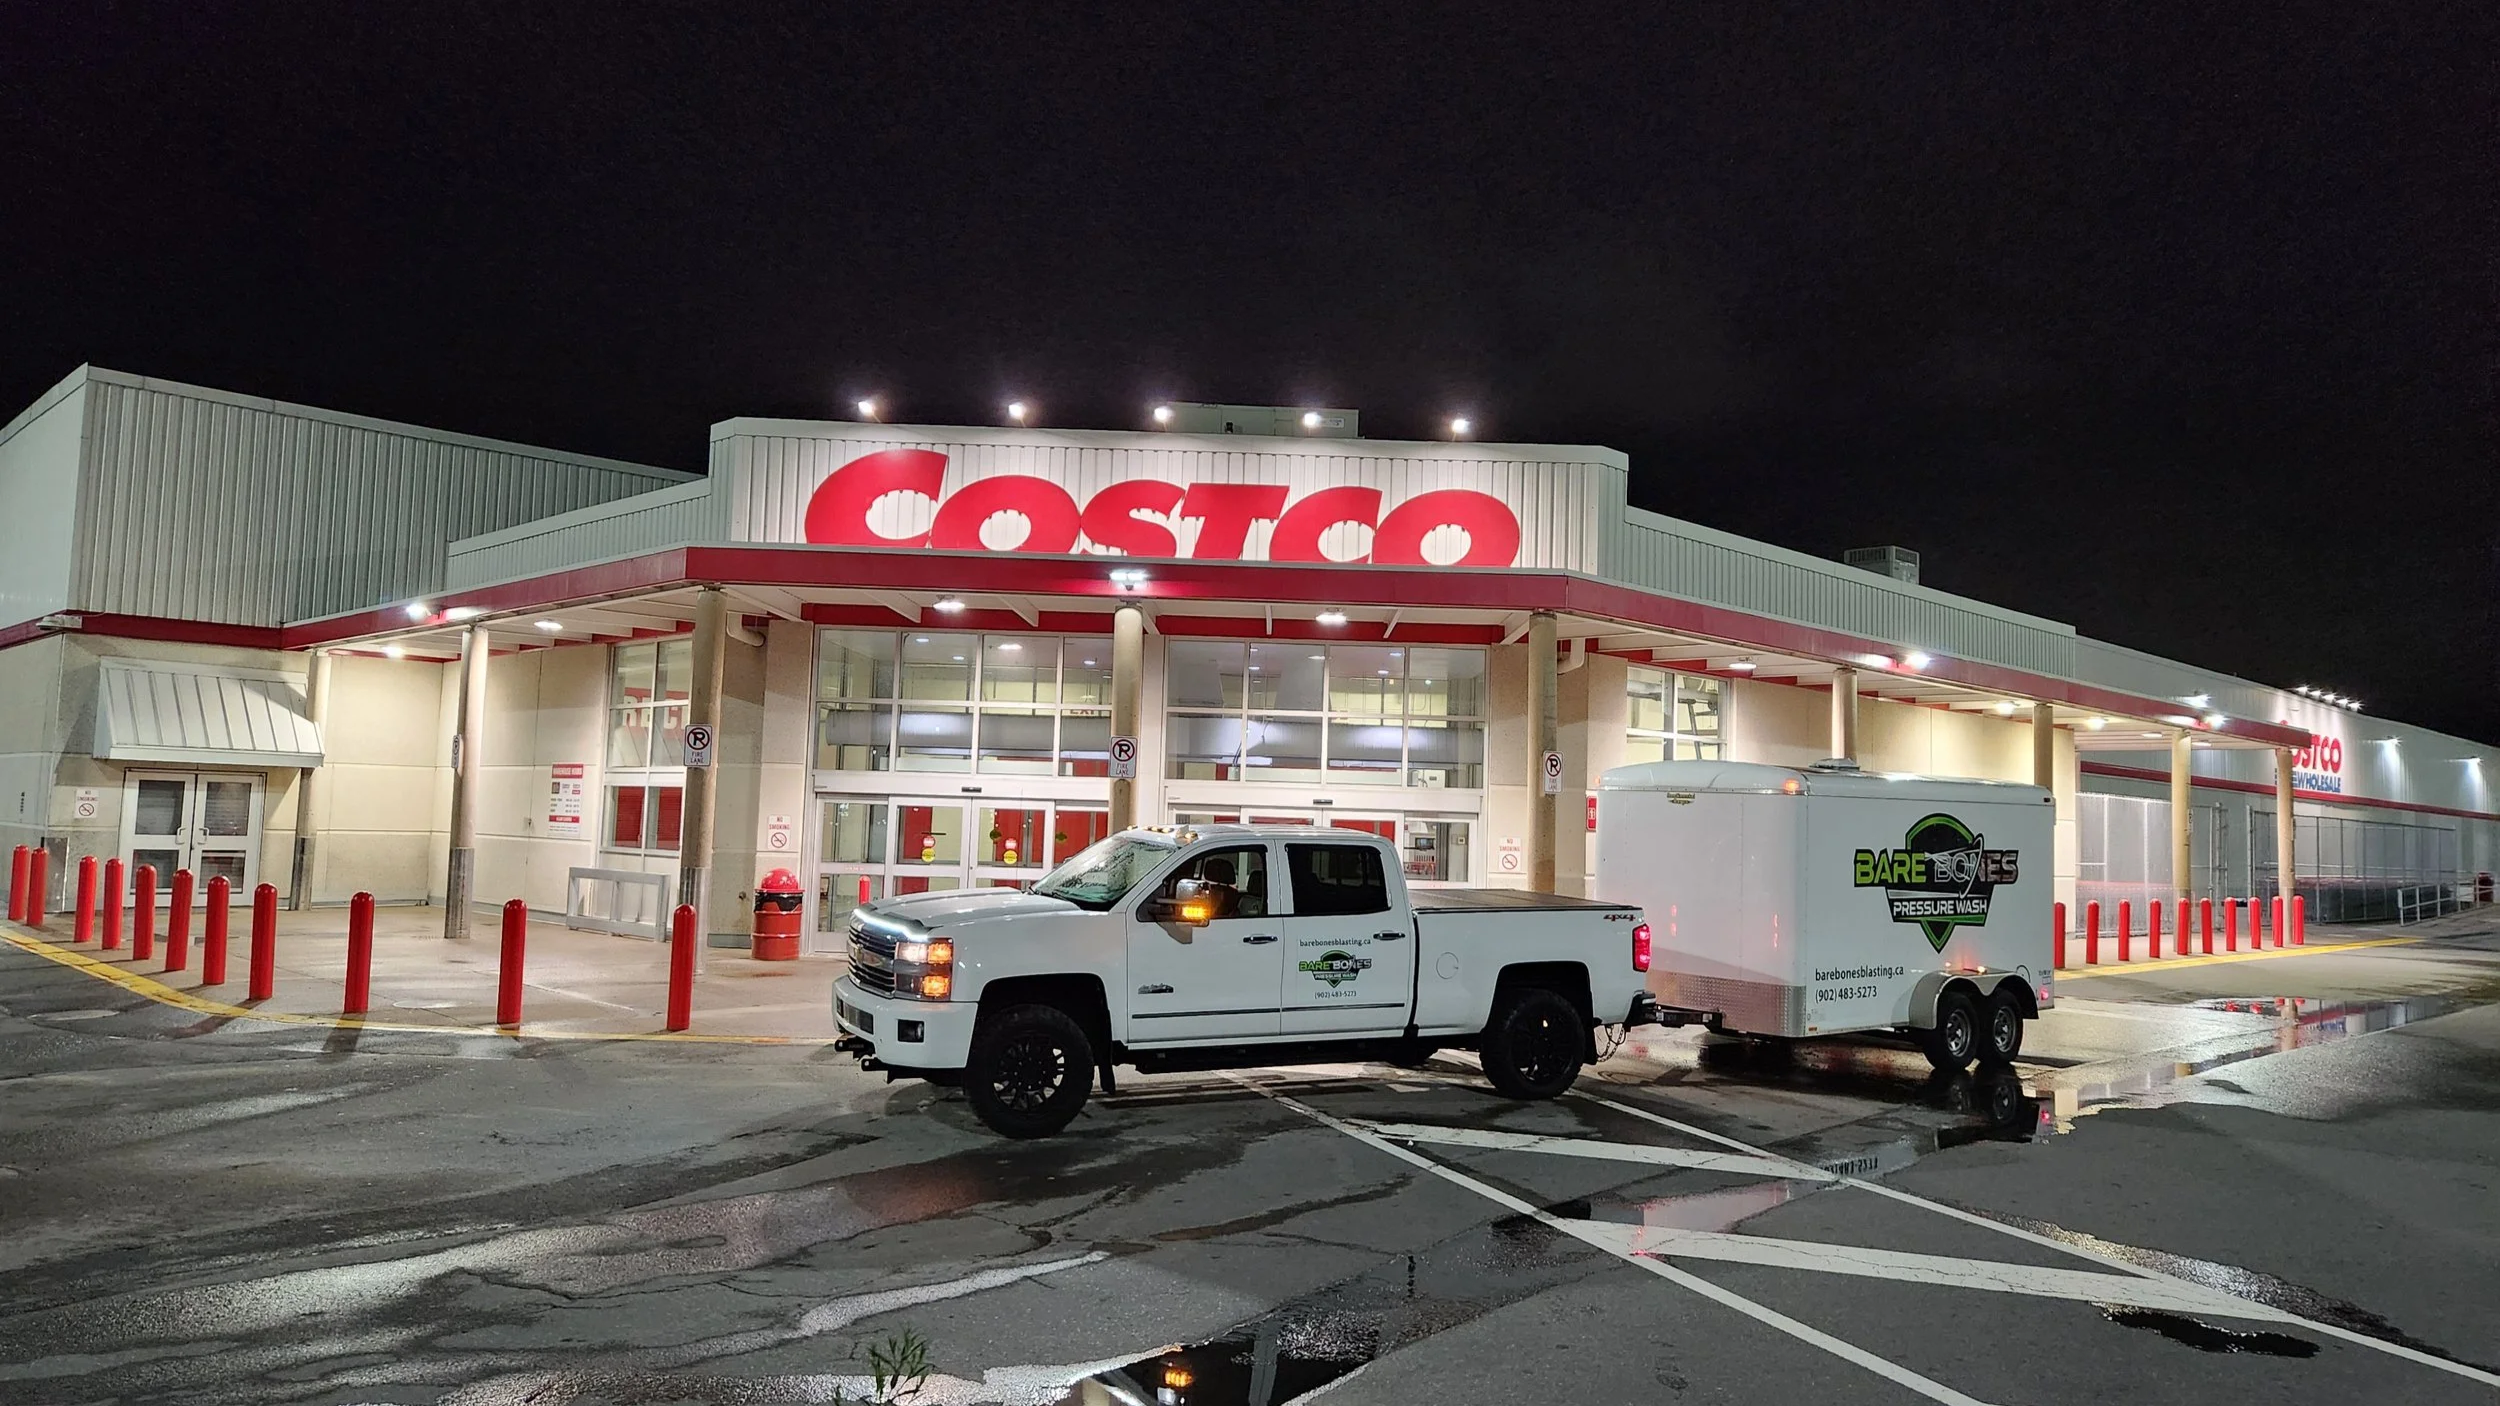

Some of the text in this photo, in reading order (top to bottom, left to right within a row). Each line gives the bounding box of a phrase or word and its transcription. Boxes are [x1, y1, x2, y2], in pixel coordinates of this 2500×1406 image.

[804, 448, 1520, 568] COSTCO
[2297, 770, 2342, 793] WHOLESALE
[1855, 851, 2018, 884] BARE BONES
[1893, 899, 1987, 916] PRESSURE WASH
[1299, 937, 1371, 947] barebonesblasting.ca
[1299, 958, 1371, 971] BARE BONES
[1815, 964, 1904, 981] barebonesblasting.ca
[1315, 990, 1357, 999] (902) 483-5273
[1815, 985, 1878, 1004] (902) 483-5273
